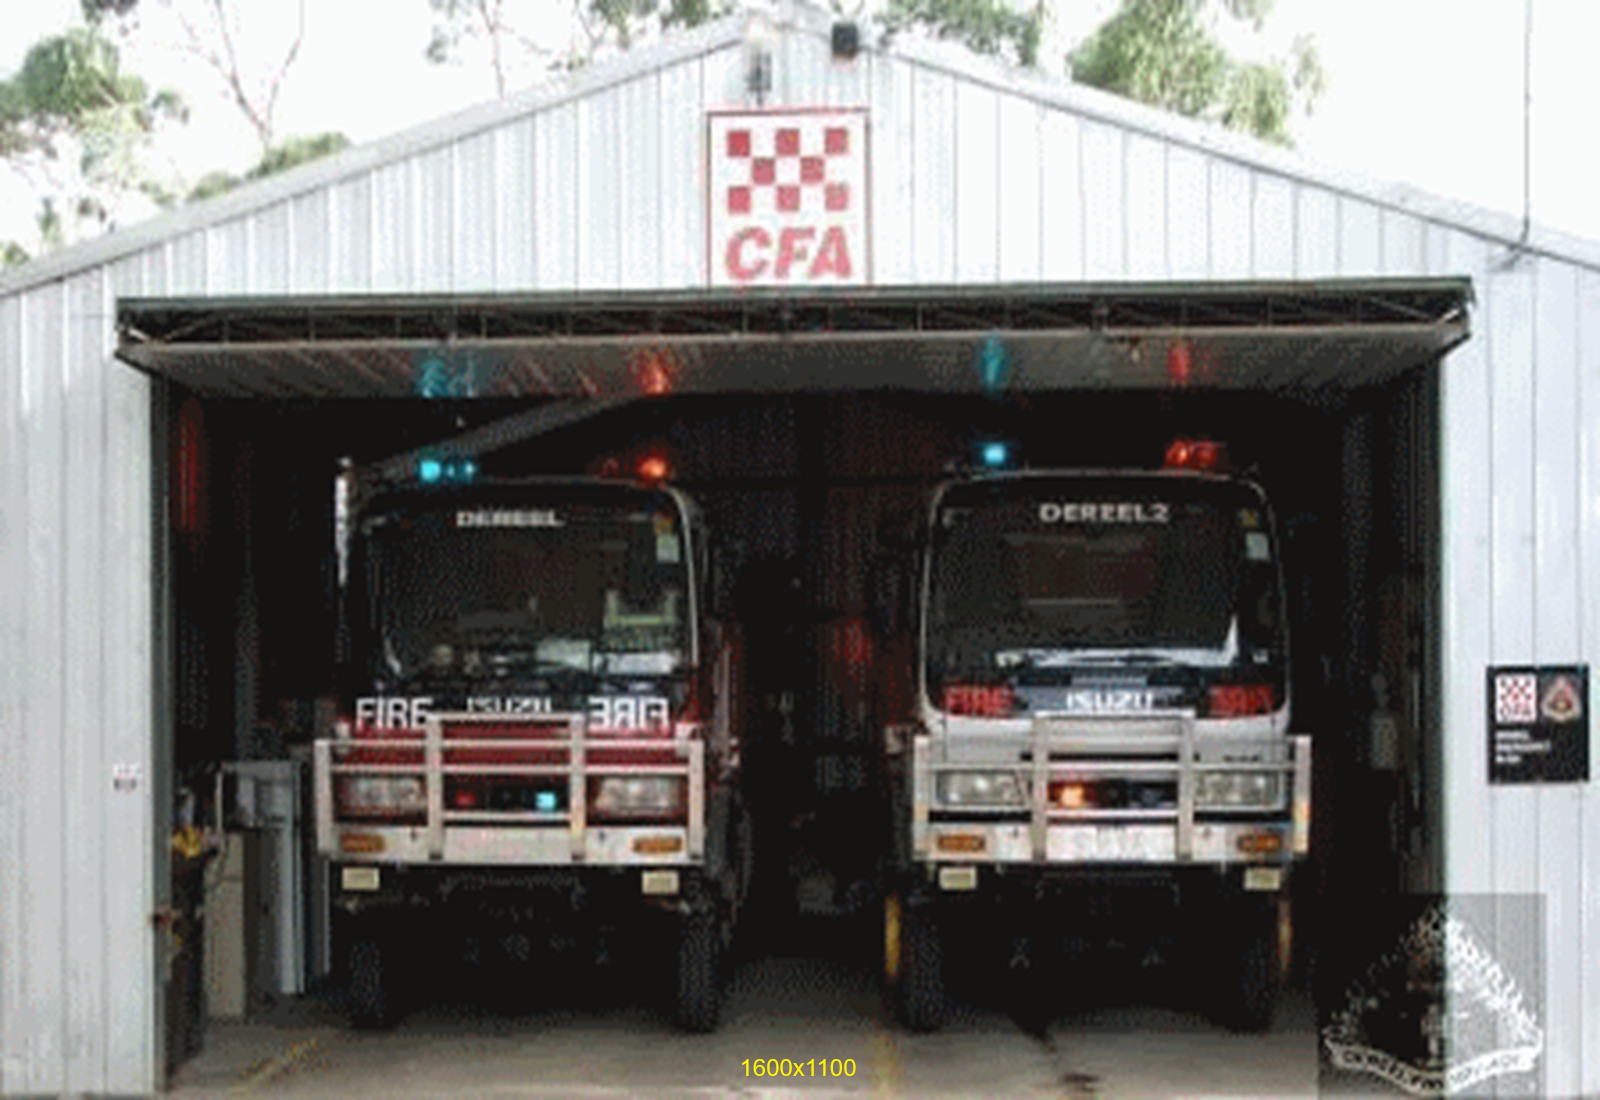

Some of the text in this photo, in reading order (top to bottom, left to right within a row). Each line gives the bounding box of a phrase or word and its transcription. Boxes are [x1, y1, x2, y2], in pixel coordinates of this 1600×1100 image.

[725, 225, 852, 281] CFA
[355, 696, 434, 732] FIRE
[466, 696, 552, 714] ISUZU
[1066, 690, 1154, 712] ISUZU
